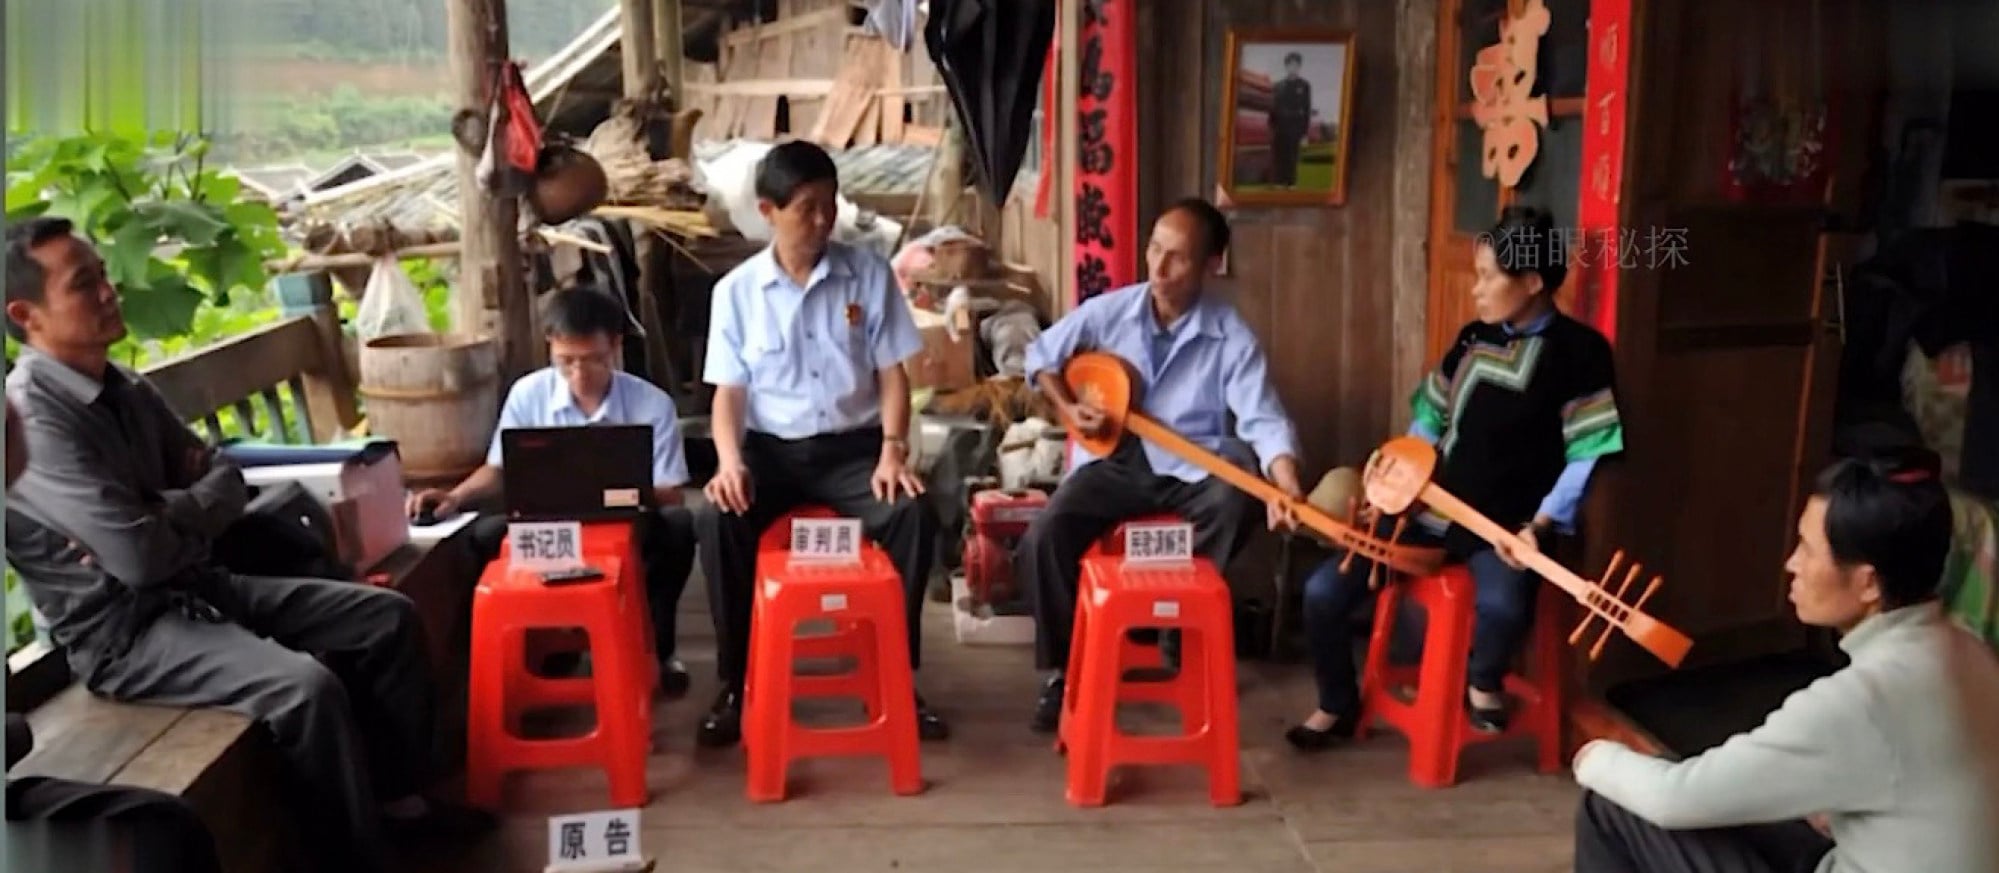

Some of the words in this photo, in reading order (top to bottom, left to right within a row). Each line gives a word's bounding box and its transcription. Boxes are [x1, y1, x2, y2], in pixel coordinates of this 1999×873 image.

[517, 528, 576, 559] 书记员
[795, 525, 851, 554] 审判员
[559, 817, 632, 860] 原告
